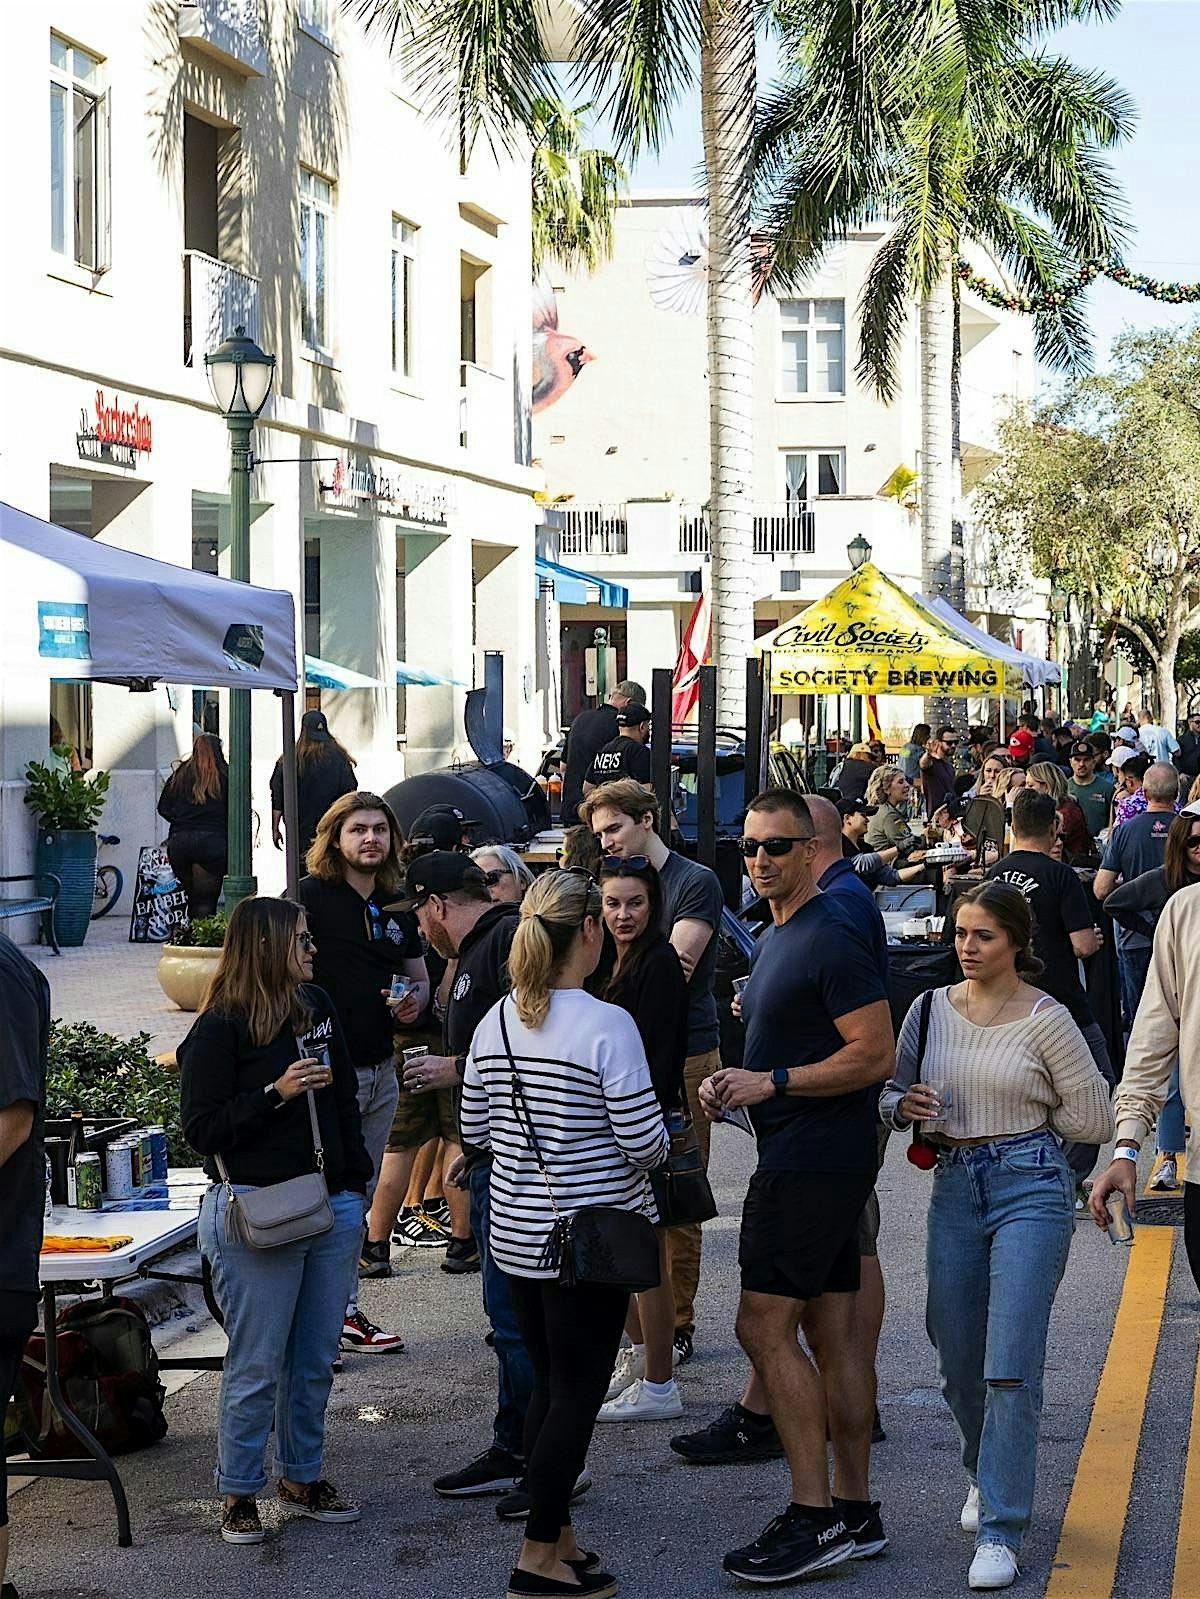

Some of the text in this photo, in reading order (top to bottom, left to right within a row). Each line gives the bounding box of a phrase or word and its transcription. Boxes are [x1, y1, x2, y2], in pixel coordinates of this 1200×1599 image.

[773, 622, 929, 652] Civil Society
[780, 670, 997, 686] SOCIETY BREWING
[817, 1520, 847, 1546] HOKA
